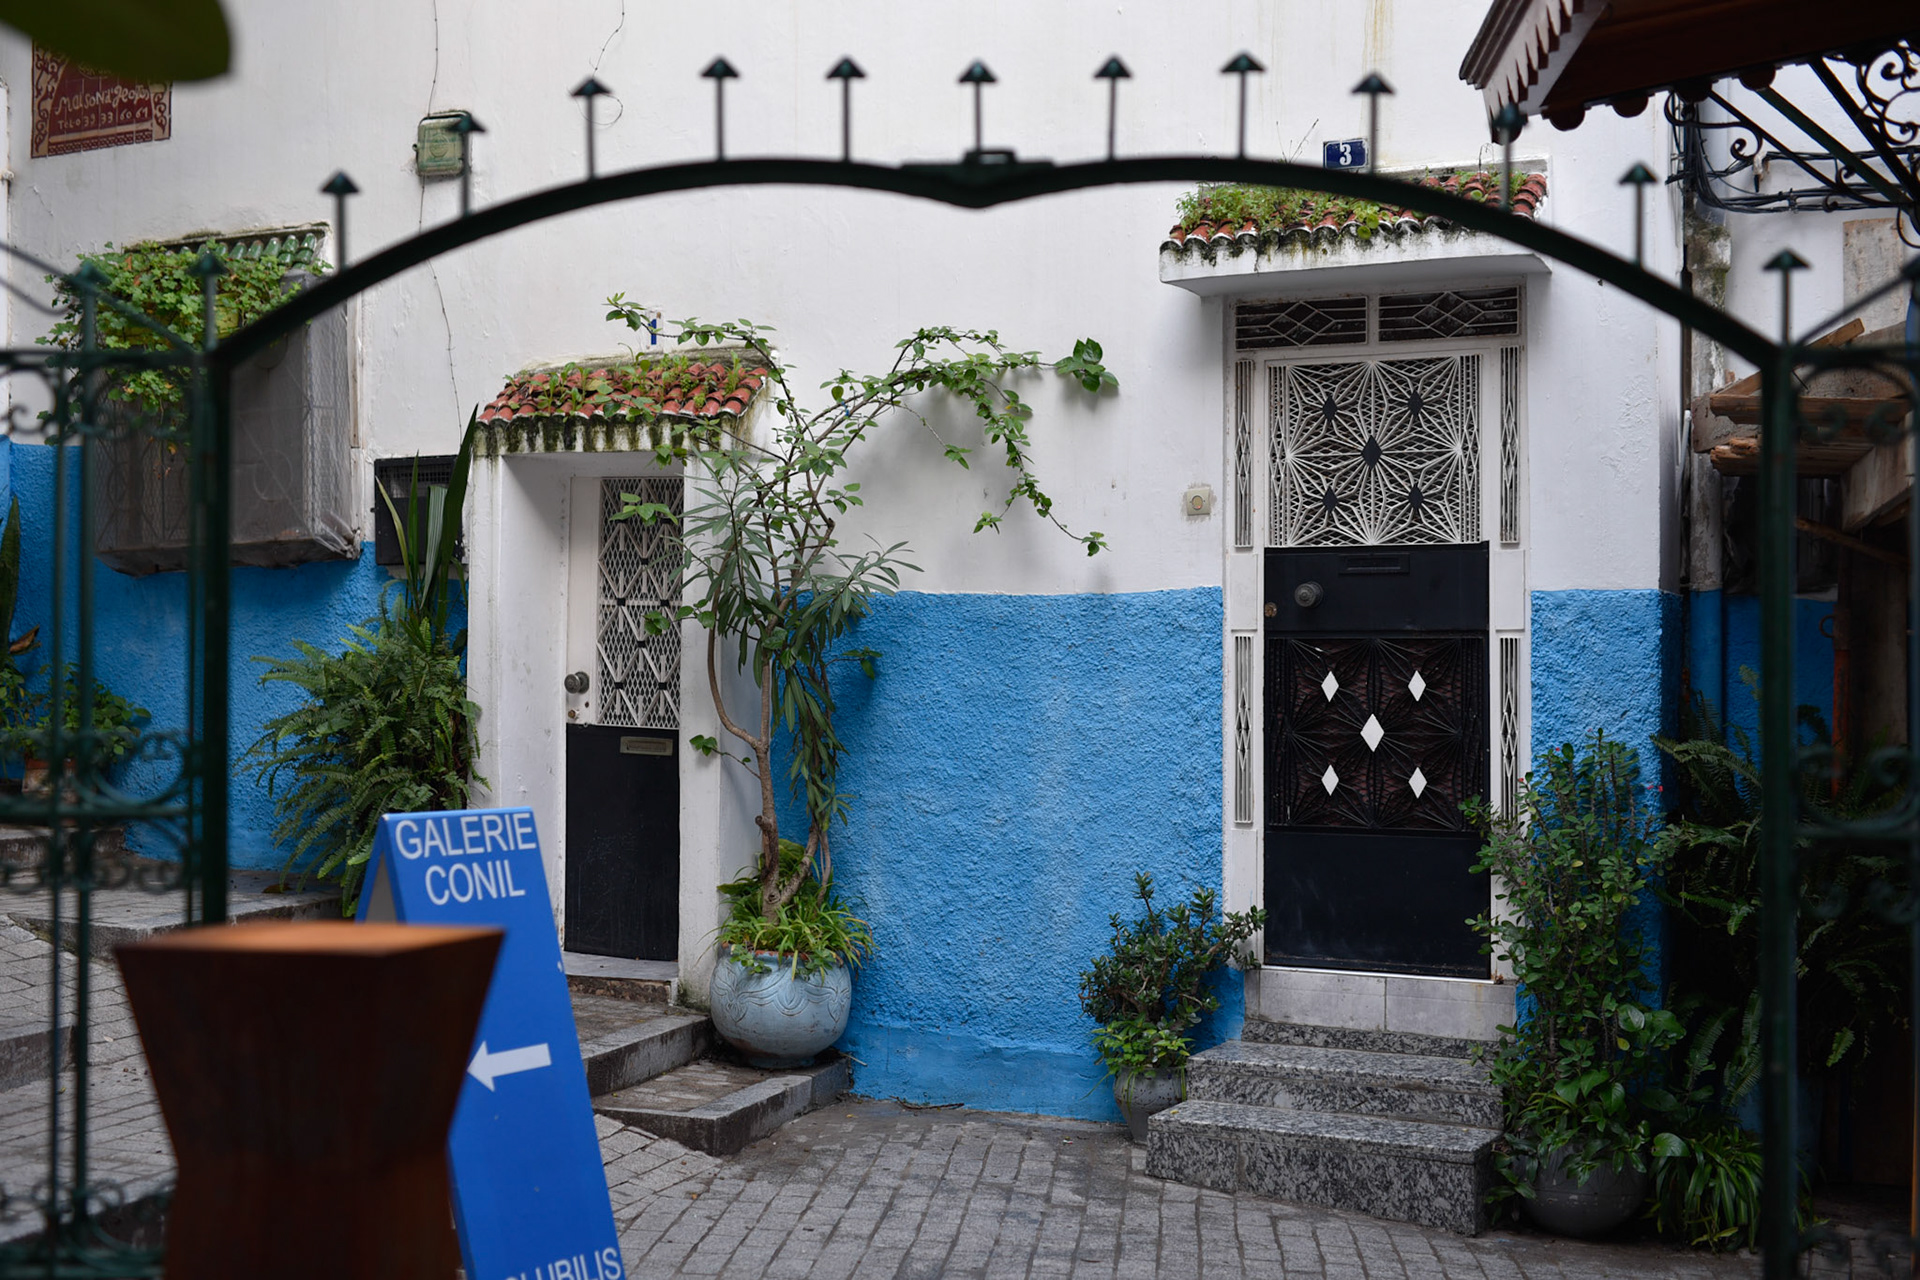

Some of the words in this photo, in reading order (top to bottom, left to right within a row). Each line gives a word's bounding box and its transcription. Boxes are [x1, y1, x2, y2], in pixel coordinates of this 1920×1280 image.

[120, 109, 132, 120] 60
[1339, 144, 1352, 166] 3
[395, 812, 537, 860] GALERIE
[425, 859, 526, 905] CONIL
